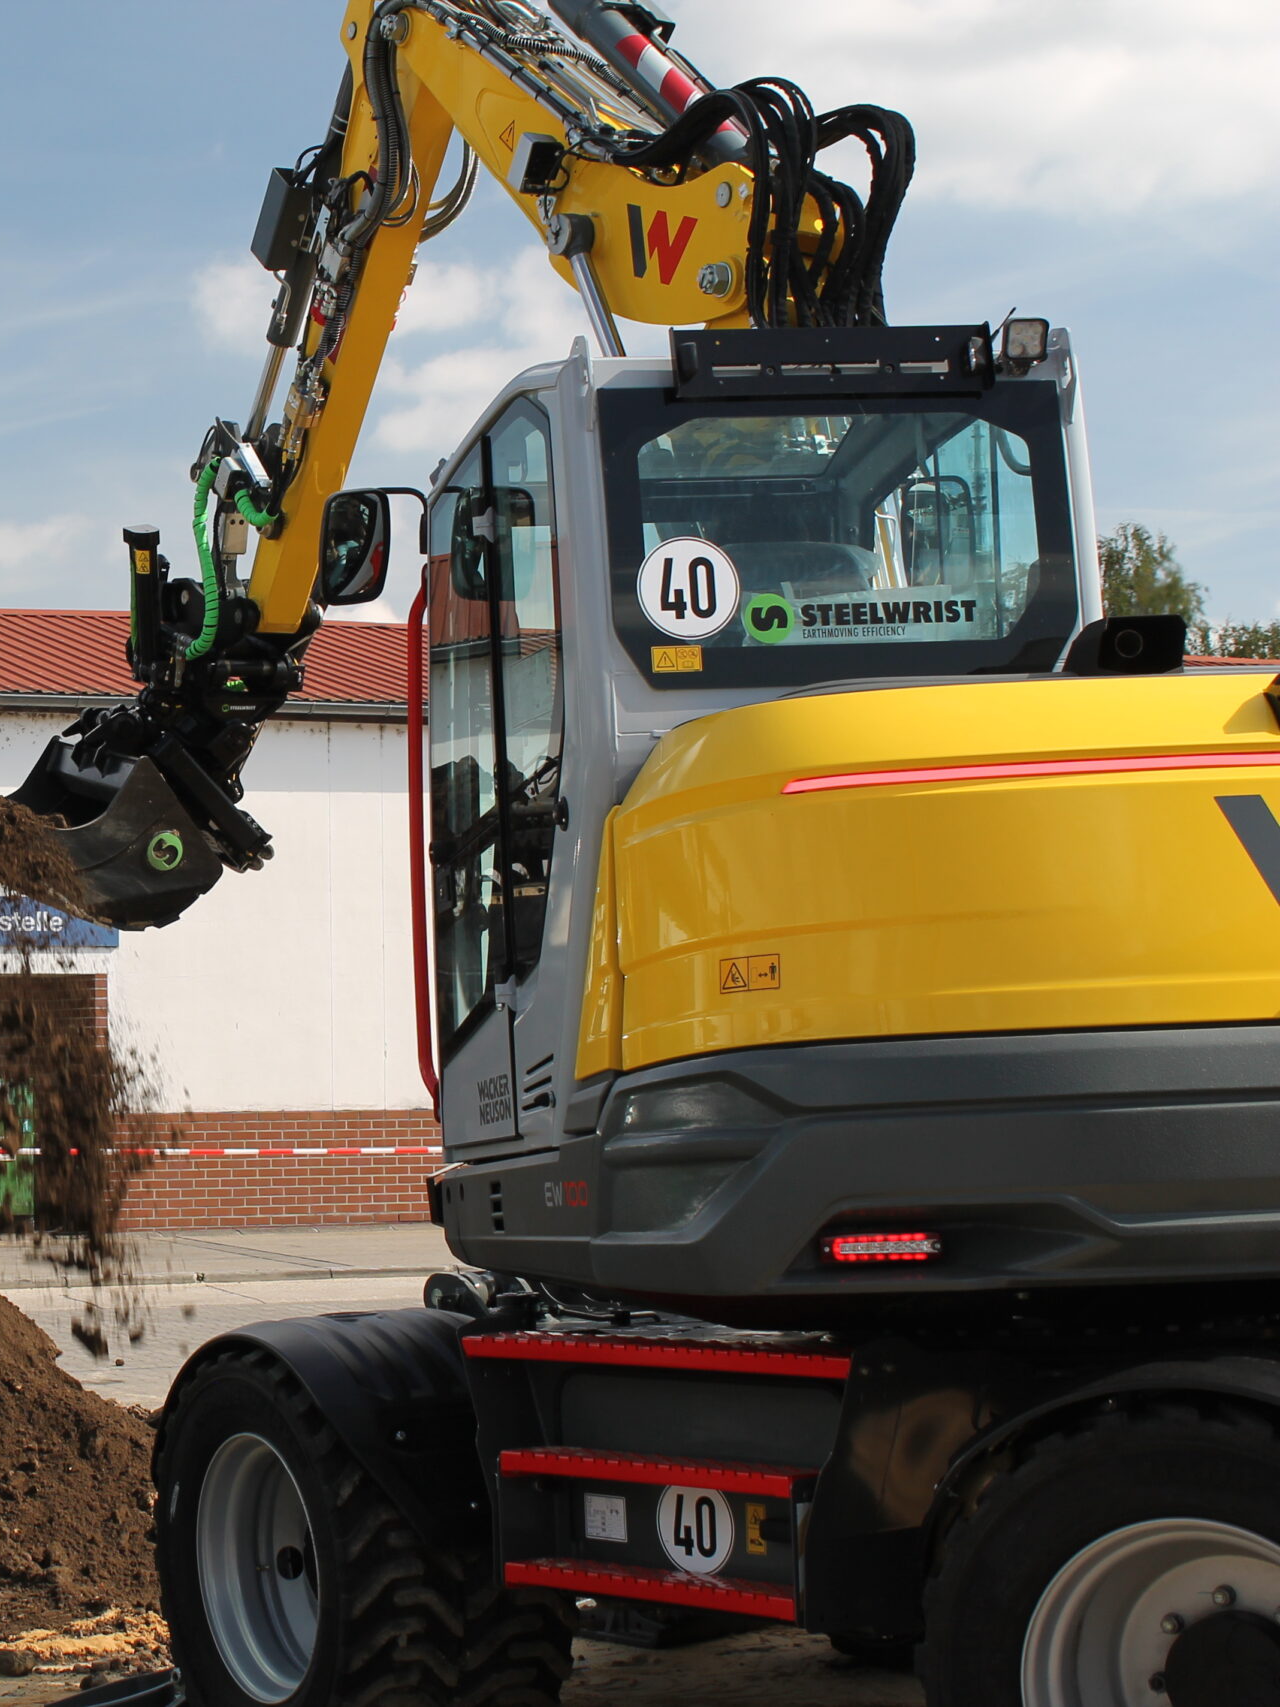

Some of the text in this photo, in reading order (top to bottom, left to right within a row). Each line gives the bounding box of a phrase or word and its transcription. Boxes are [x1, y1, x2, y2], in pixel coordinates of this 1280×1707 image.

[660, 557, 717, 619] 40
[800, 600, 976, 627] STEELWRIST
[802, 626, 906, 639] EARTHMOVING EFFICIENCY
[477, 1074, 510, 1102] WACKER
[479, 1098, 512, 1126] NEUSON
[674, 1494, 717, 1558] 40
